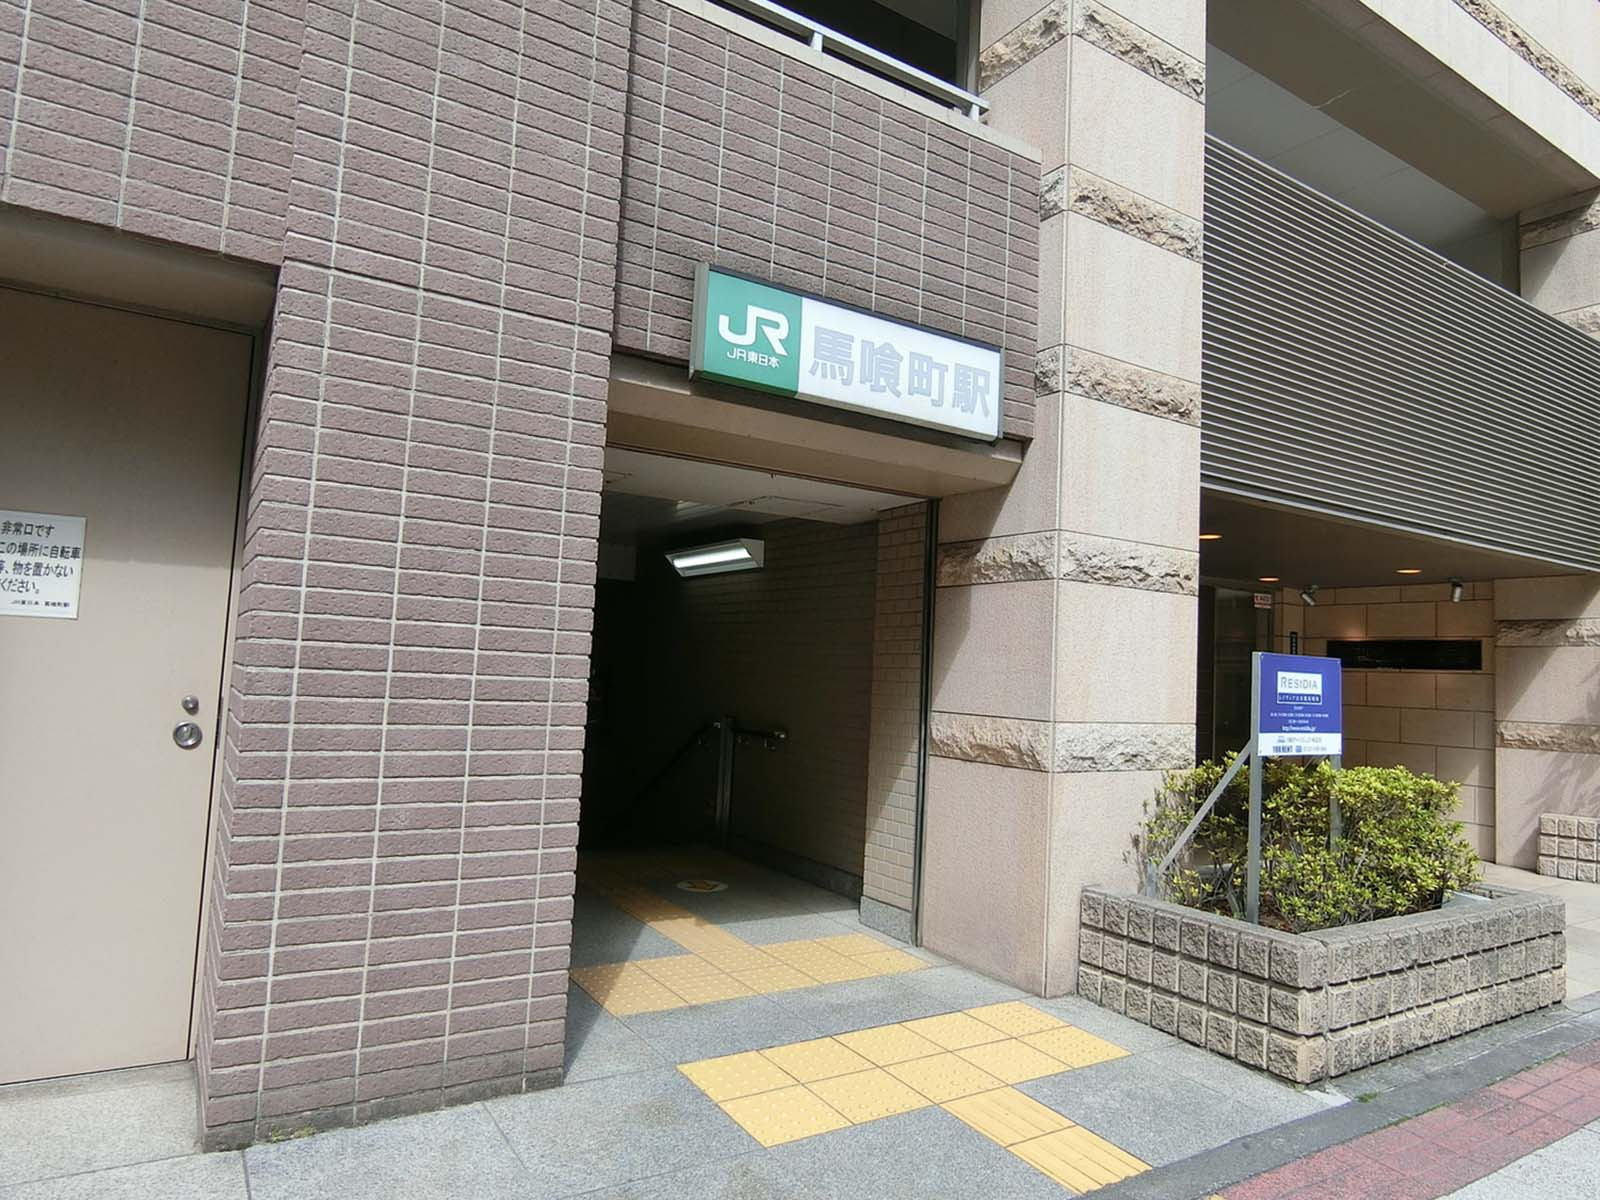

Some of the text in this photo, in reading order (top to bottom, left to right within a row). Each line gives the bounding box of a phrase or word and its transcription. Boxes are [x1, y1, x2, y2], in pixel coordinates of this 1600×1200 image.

[718, 304, 790, 356] JR
[726, 346, 780, 370] JR東日本
[808, 325, 991, 418] 馬喰町駅
[1, 520, 56, 538] 非常口です
